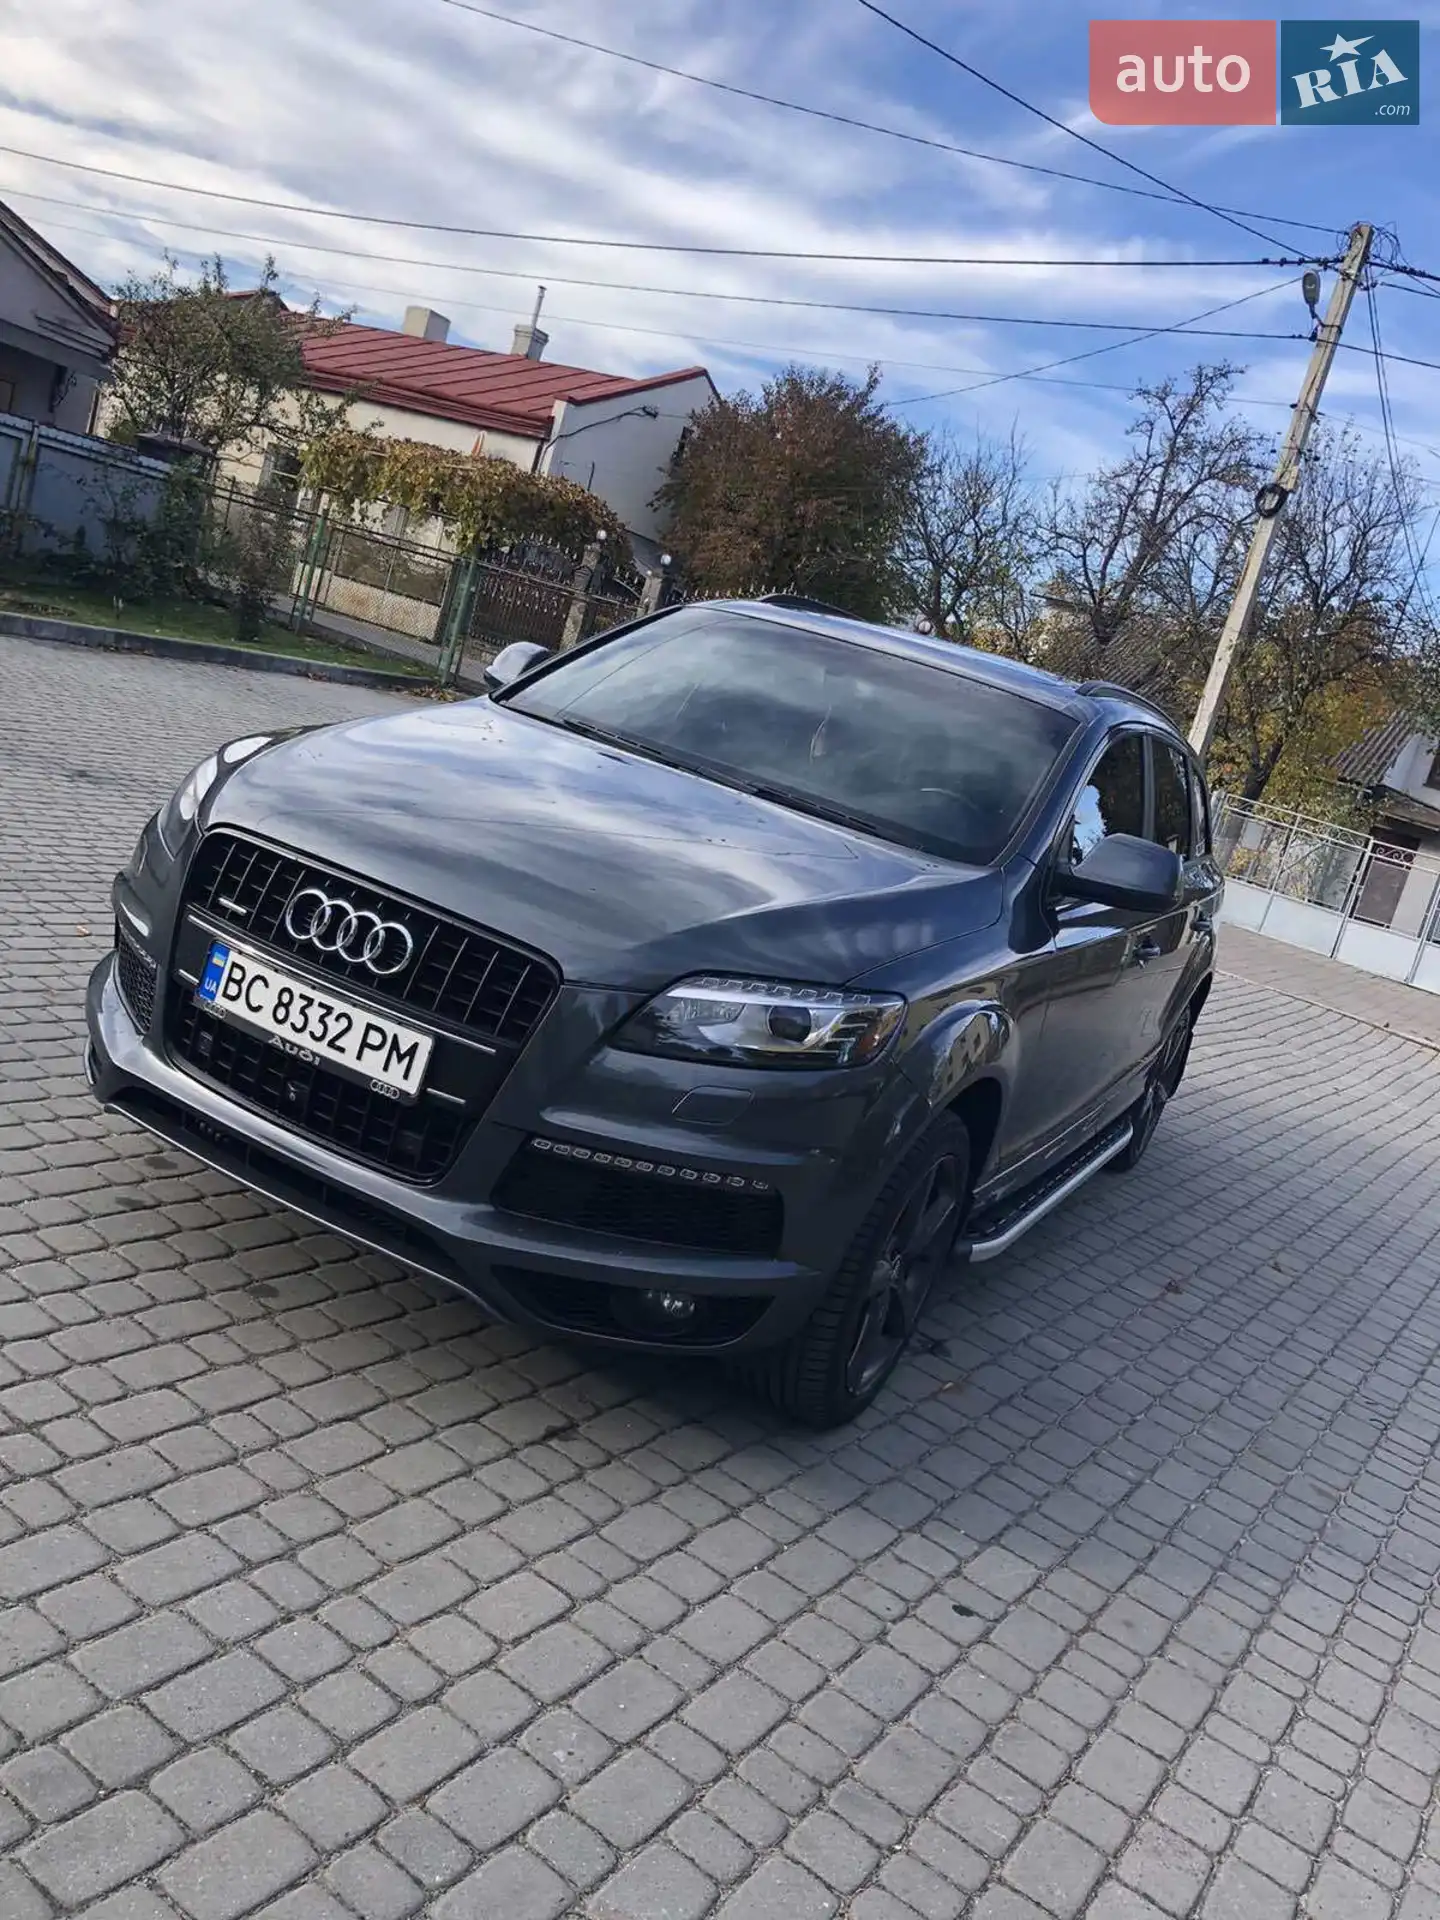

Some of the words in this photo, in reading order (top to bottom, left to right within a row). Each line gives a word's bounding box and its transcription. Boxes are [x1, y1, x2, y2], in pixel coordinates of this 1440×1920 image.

[204, 977, 217, 993] UA
[221, 961, 270, 1013] BC
[272, 987, 353, 1053] 8332
[355, 1022, 420, 1080] PM
